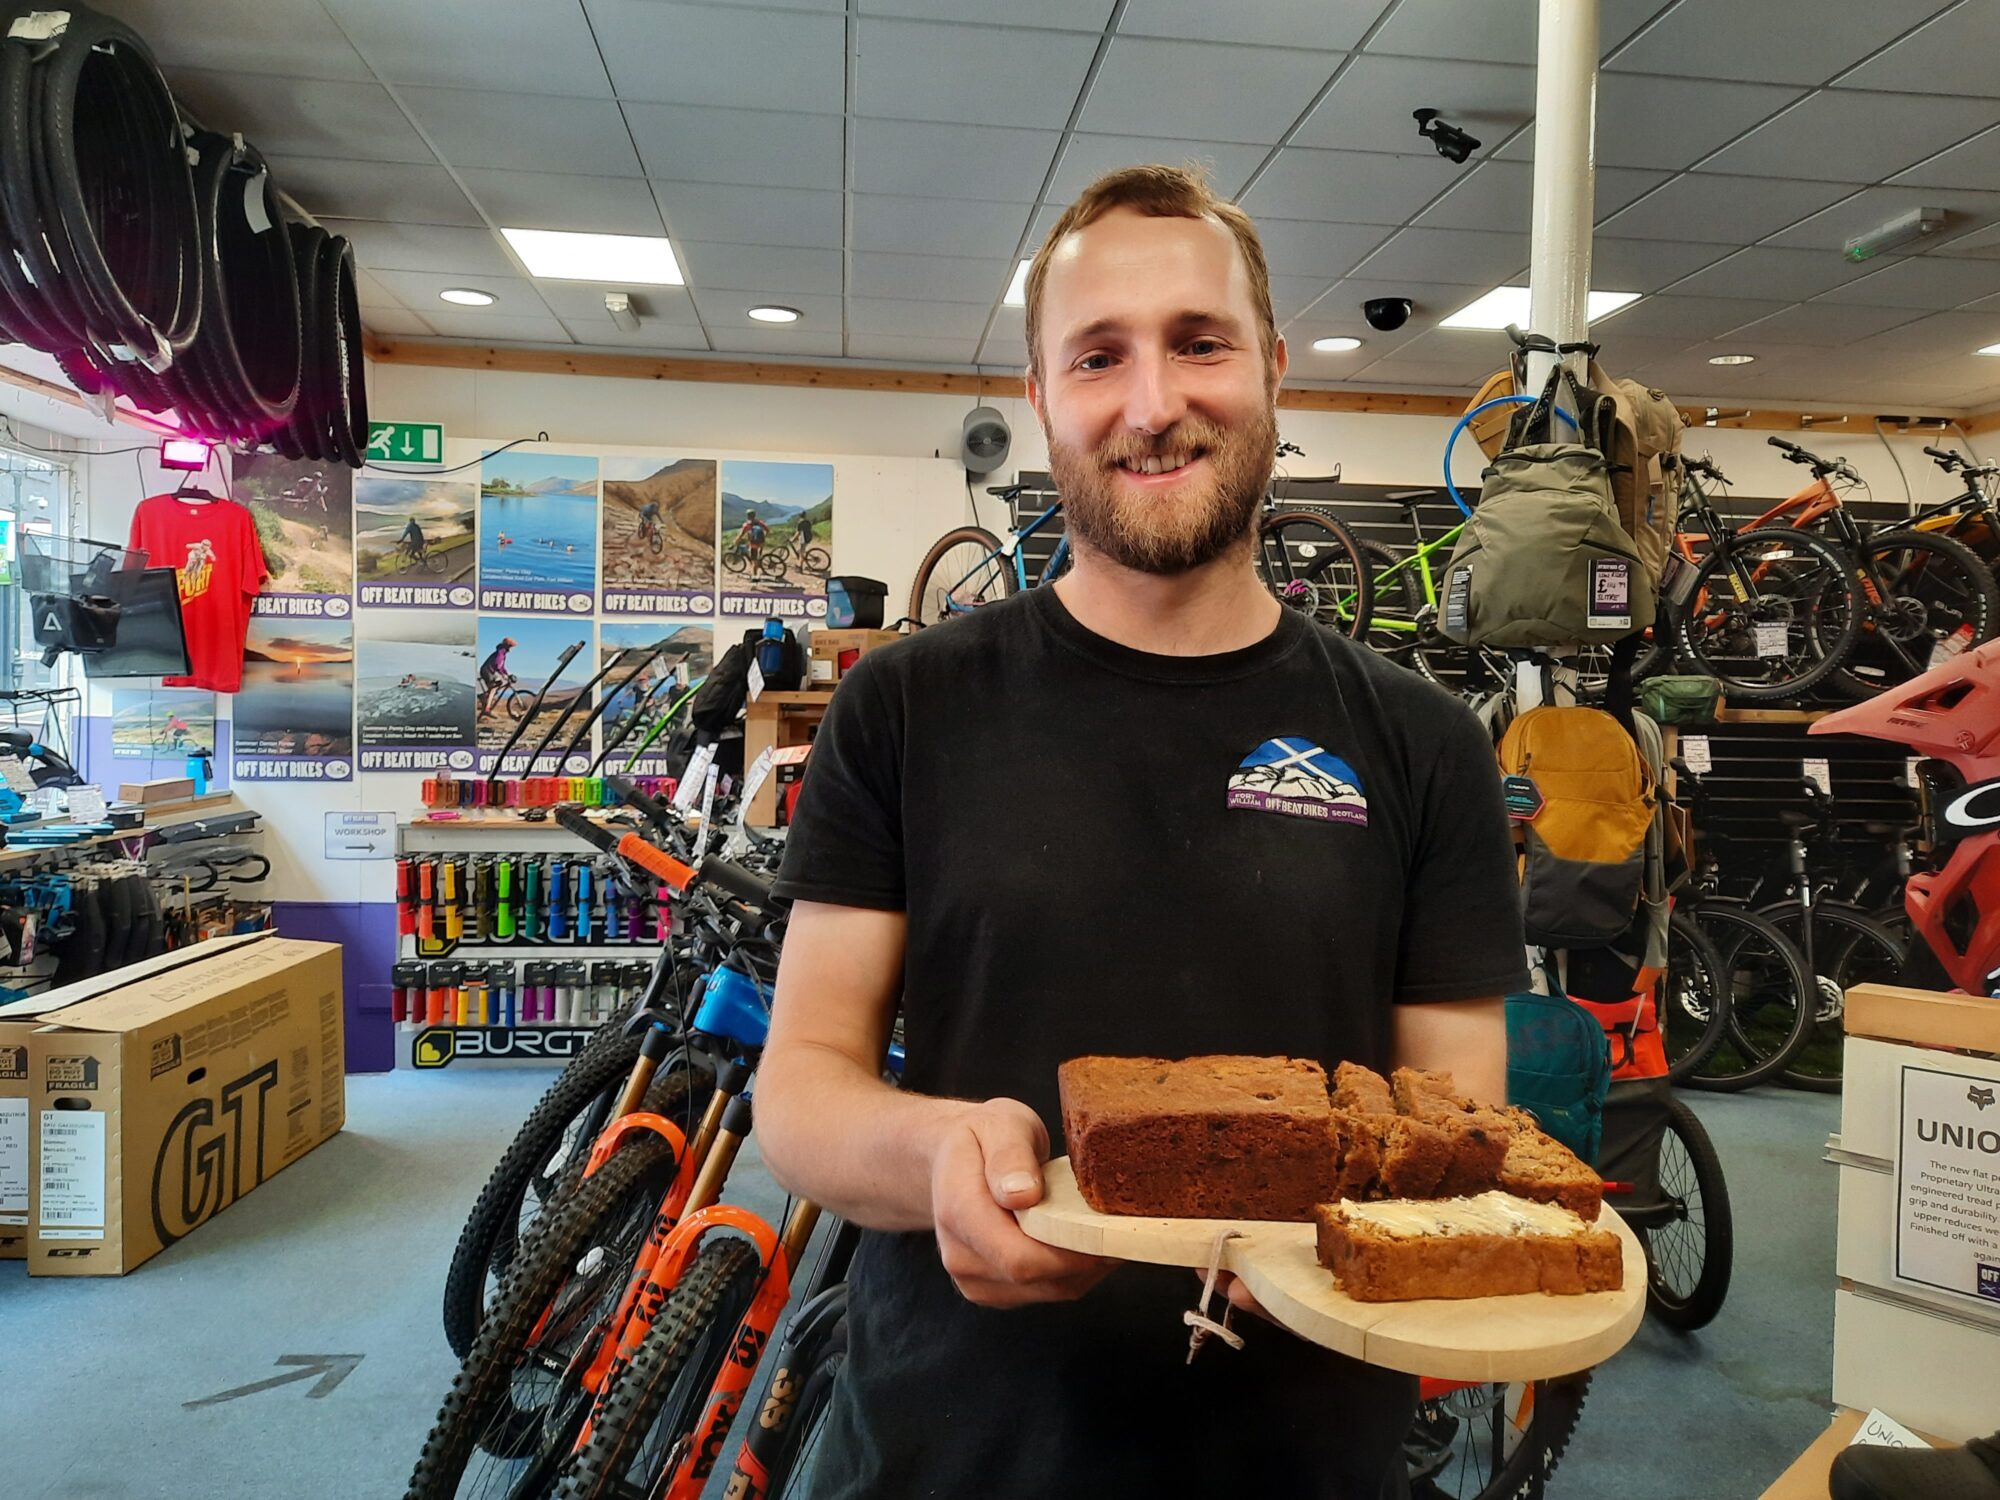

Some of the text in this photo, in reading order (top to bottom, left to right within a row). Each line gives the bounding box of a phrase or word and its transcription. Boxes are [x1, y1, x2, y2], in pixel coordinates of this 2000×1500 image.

[361, 586, 448, 605] OFF BEAT BIKES
[482, 591, 566, 610] OFF BEAT BIKES
[605, 594, 688, 612] OFF BEAT BIKES
[258, 597, 288, 614] BEAT
[288, 599, 322, 615] BIKES
[722, 597, 804, 615] OFF BEAT BIKES
[361, 752, 447, 768] OFF BEAT BIKES
[236, 761, 323, 778] OFF BEAT BIKES
[1229, 798, 1261, 807] WILLIAM
[1265, 798, 1328, 818] OFF BEAT BIKES
[1331, 810, 1367, 822] SCOTLAND
[334, 828, 387, 836] WORKSHOP
[48, 1081, 97, 1089] FRAGILE
[151, 1058, 278, 1249] GT
[1930, 1160, 1948, 1171] The
[1950, 1166, 1970, 1176] new
[1972, 1169, 1989, 1180] flat
[1920, 1171, 2000, 1195] Proprietary Ultra
[1908, 1197, 1928, 1208] grip
[1930, 1201, 1949, 1211] and
[1910, 1184, 1964, 1201] engineered
[1967, 1195, 1993, 1207] tread
[1913, 1211, 1942, 1222] upper
[1944, 1218, 1983, 1232] reduces
[1910, 1222, 1998, 1250] Finished off with a
